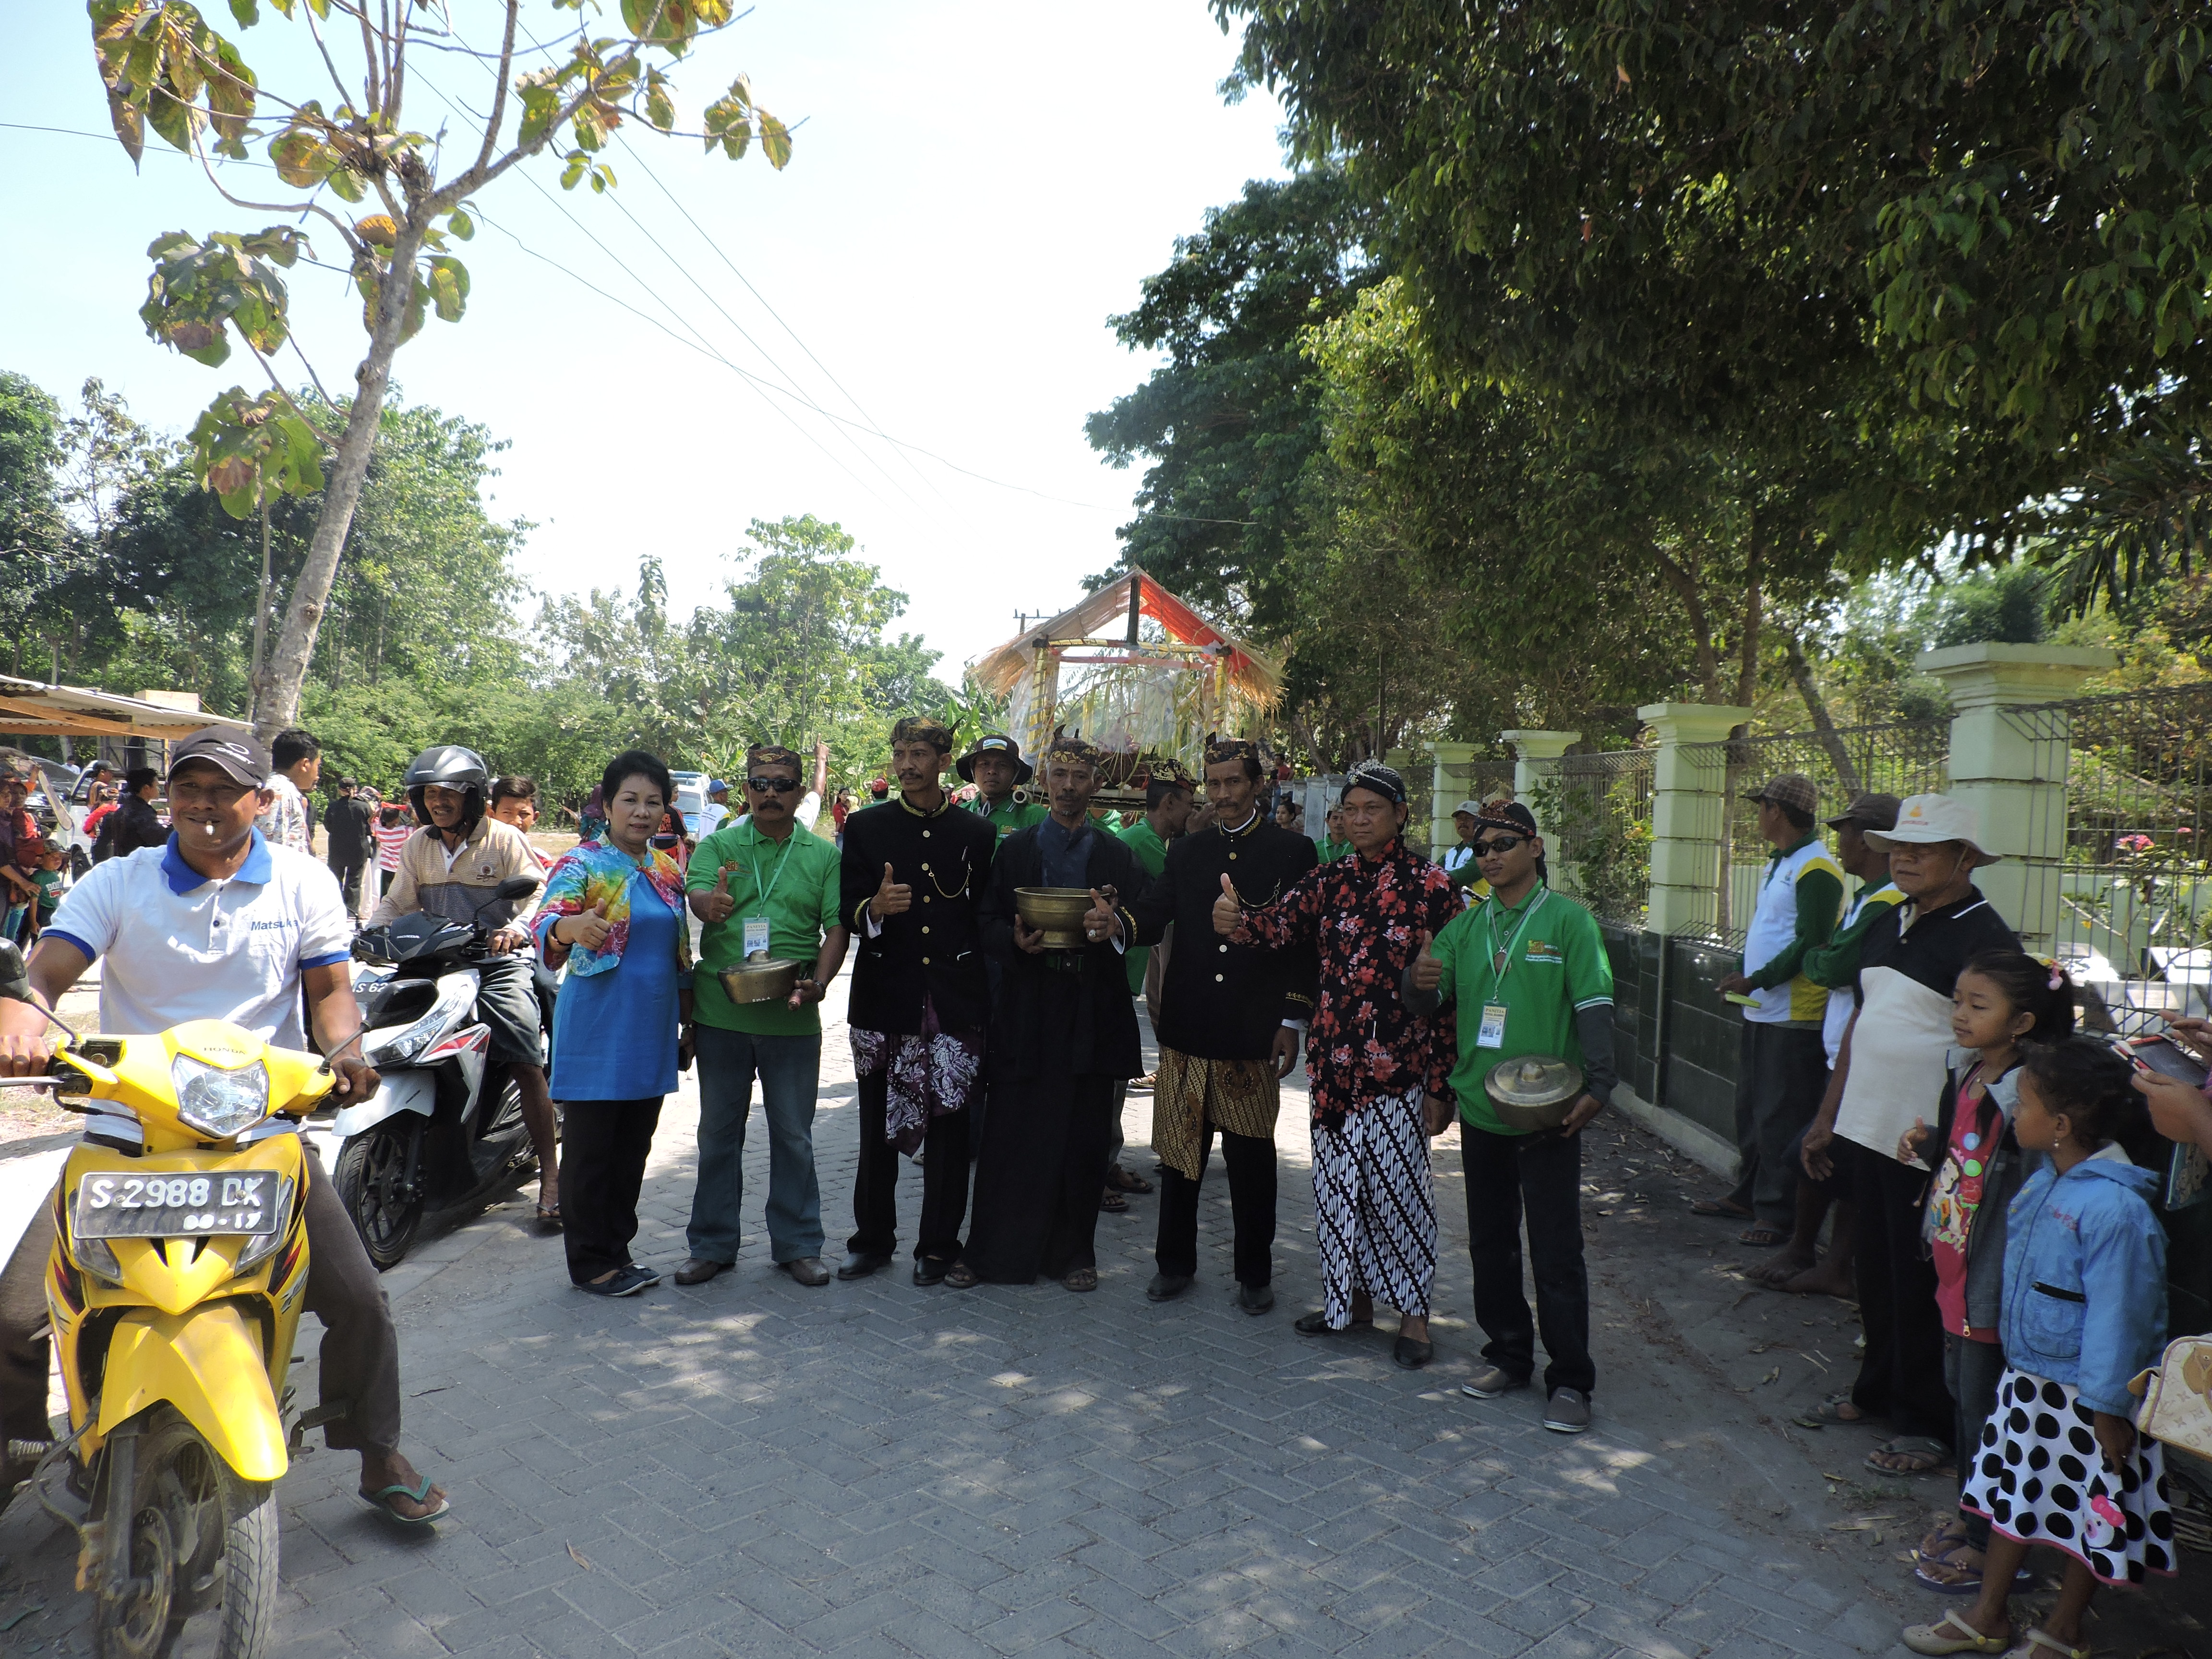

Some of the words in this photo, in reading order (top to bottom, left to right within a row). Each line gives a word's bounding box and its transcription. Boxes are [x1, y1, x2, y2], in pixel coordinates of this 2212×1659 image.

[90, 1180, 114, 1208] S
[122, 1178, 210, 1208] 2988
[221, 1178, 264, 1207] DK
